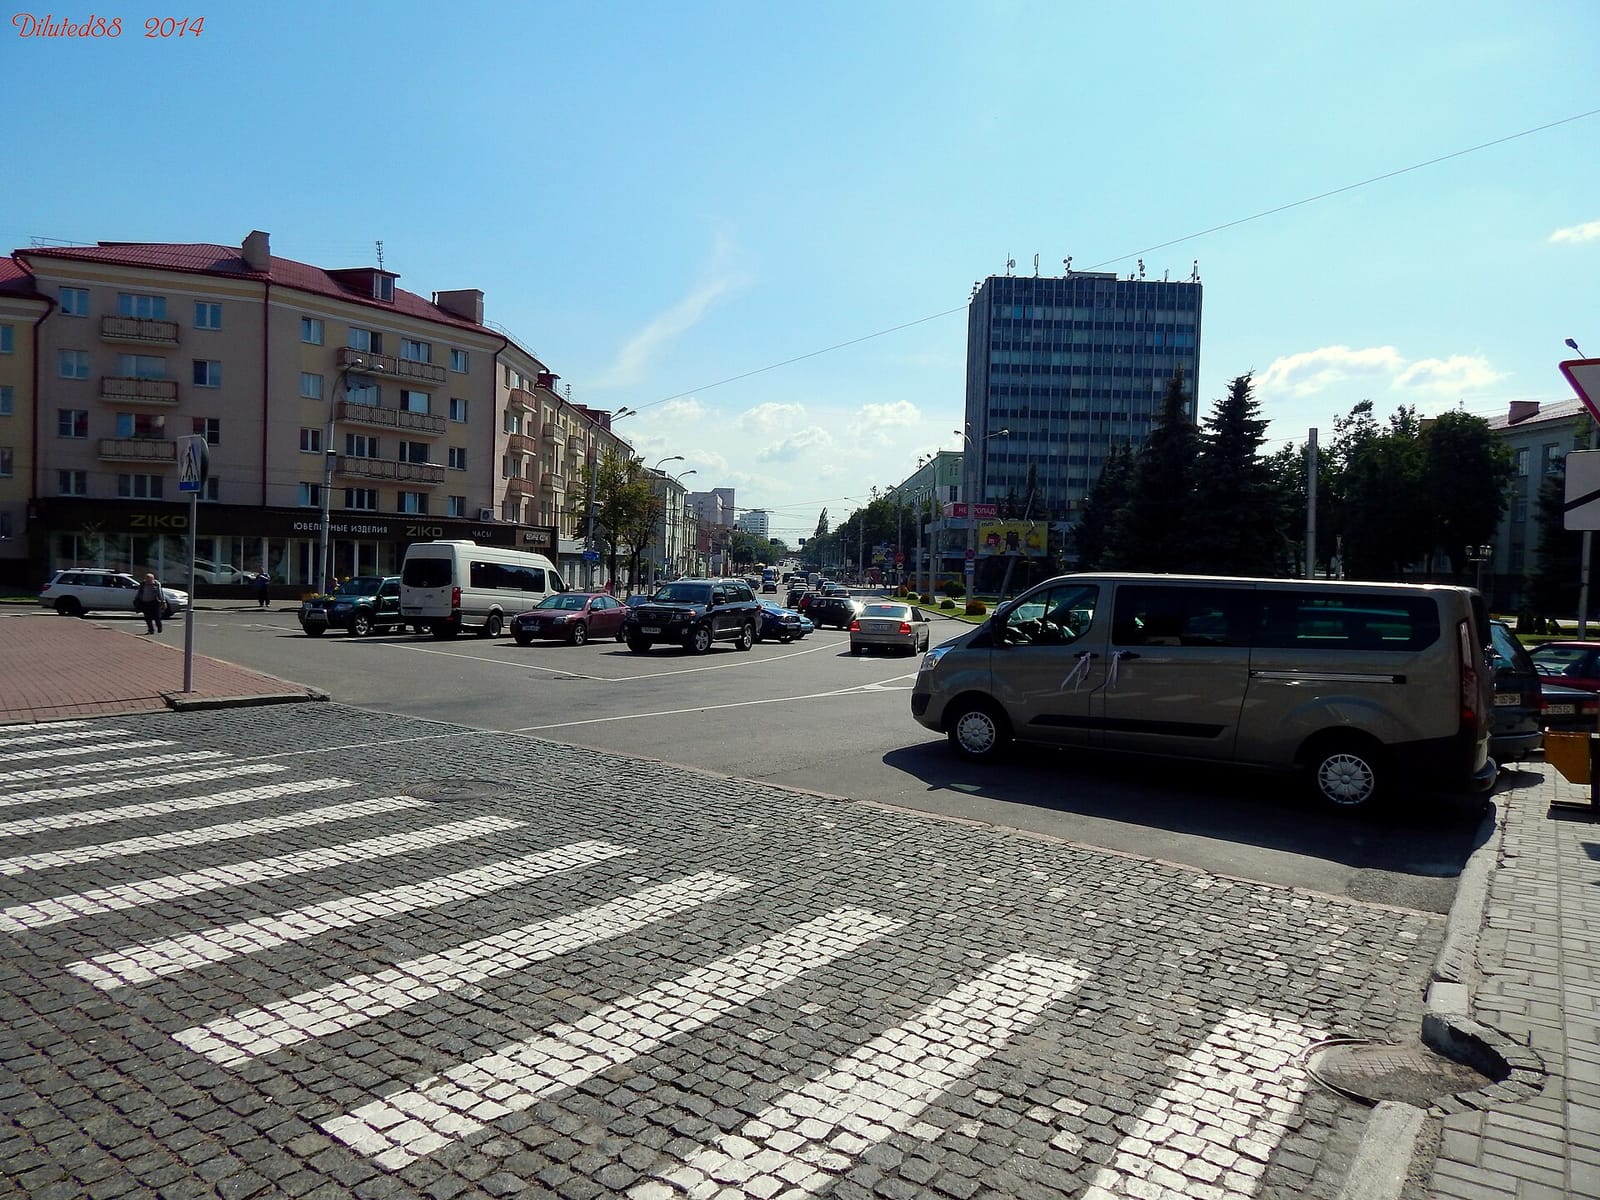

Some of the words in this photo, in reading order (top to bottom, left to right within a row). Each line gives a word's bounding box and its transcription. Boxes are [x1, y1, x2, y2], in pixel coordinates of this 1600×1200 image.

[128, 514, 188, 528] ZIKO
[293, 522, 348, 532] ЮВЕЛНЫЕ
[351, 525, 387, 533] ИЗДЕЛИЯ
[406, 526, 443, 537] ZIKO
[472, 530, 492, 538] ЧАСЫ
